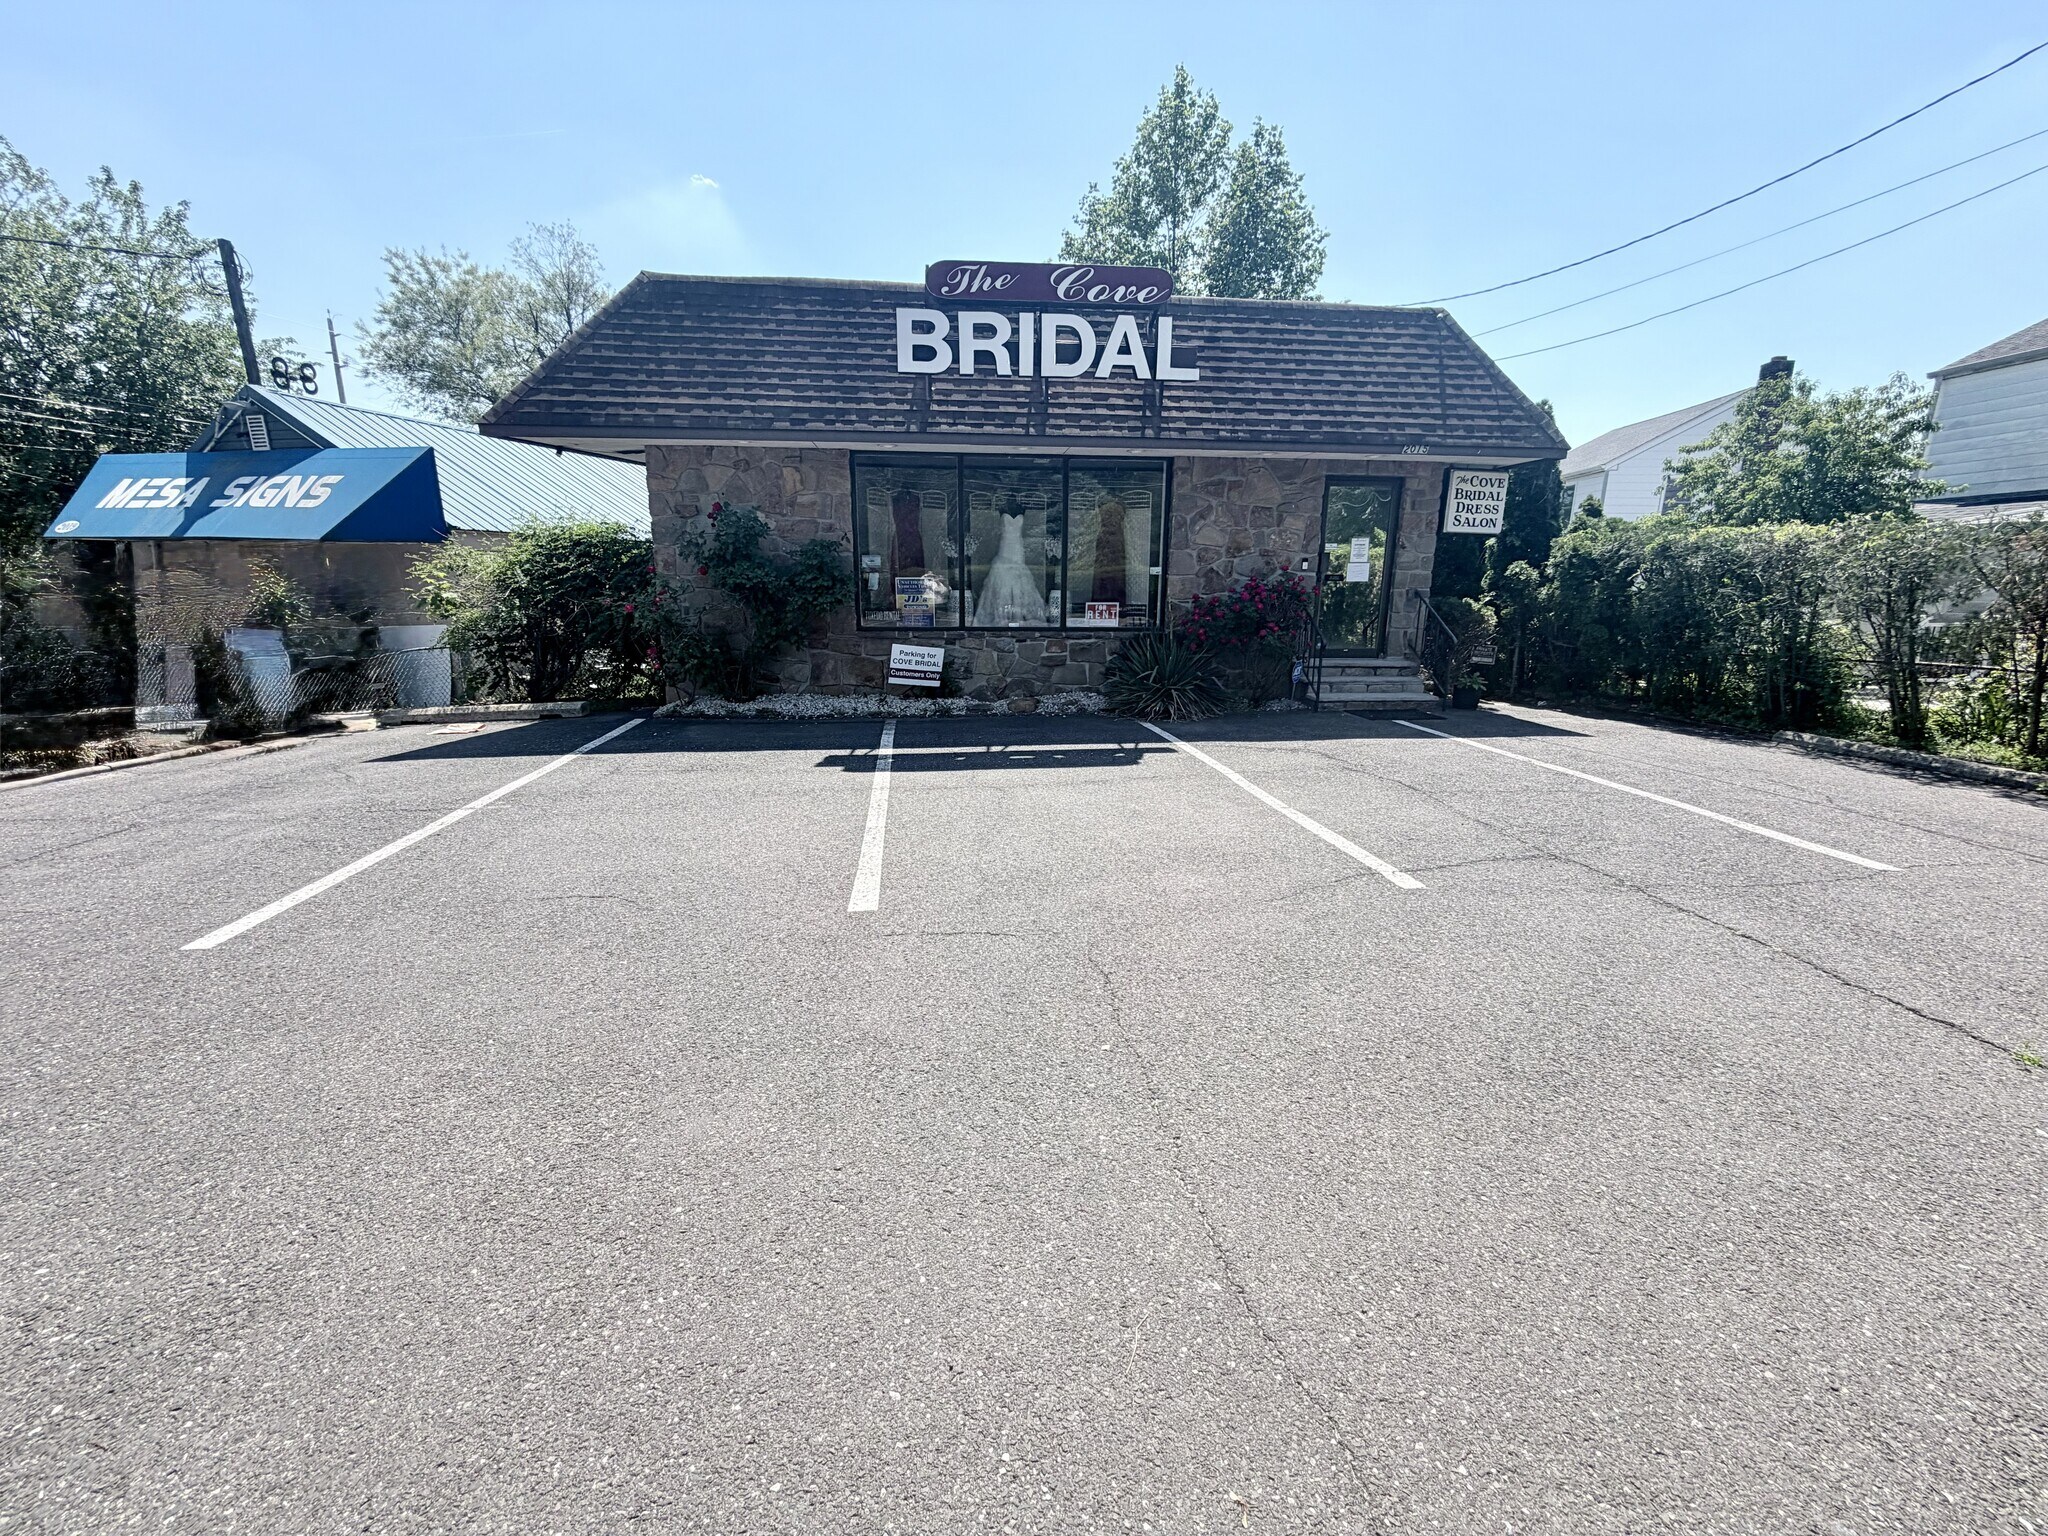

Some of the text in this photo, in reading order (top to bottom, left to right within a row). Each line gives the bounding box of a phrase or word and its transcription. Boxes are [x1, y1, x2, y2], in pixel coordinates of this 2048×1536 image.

[940, 264, 1170, 304] The Cove
[896, 307, 1200, 381] BRIDAL
[1456, 475, 1506, 489] The COVE
[95, 475, 345, 509] MESA SIGNS
[1454, 488, 1504, 502] BRIDAL
[1455, 501, 1500, 515] DRESS
[1452, 514, 1498, 529] SALON
[1087, 610, 1116, 619] RENT
[899, 649, 925, 659] Parking
[892, 657, 941, 668] COVE BRIDAL
[890, 669, 940, 680] Customers Only
